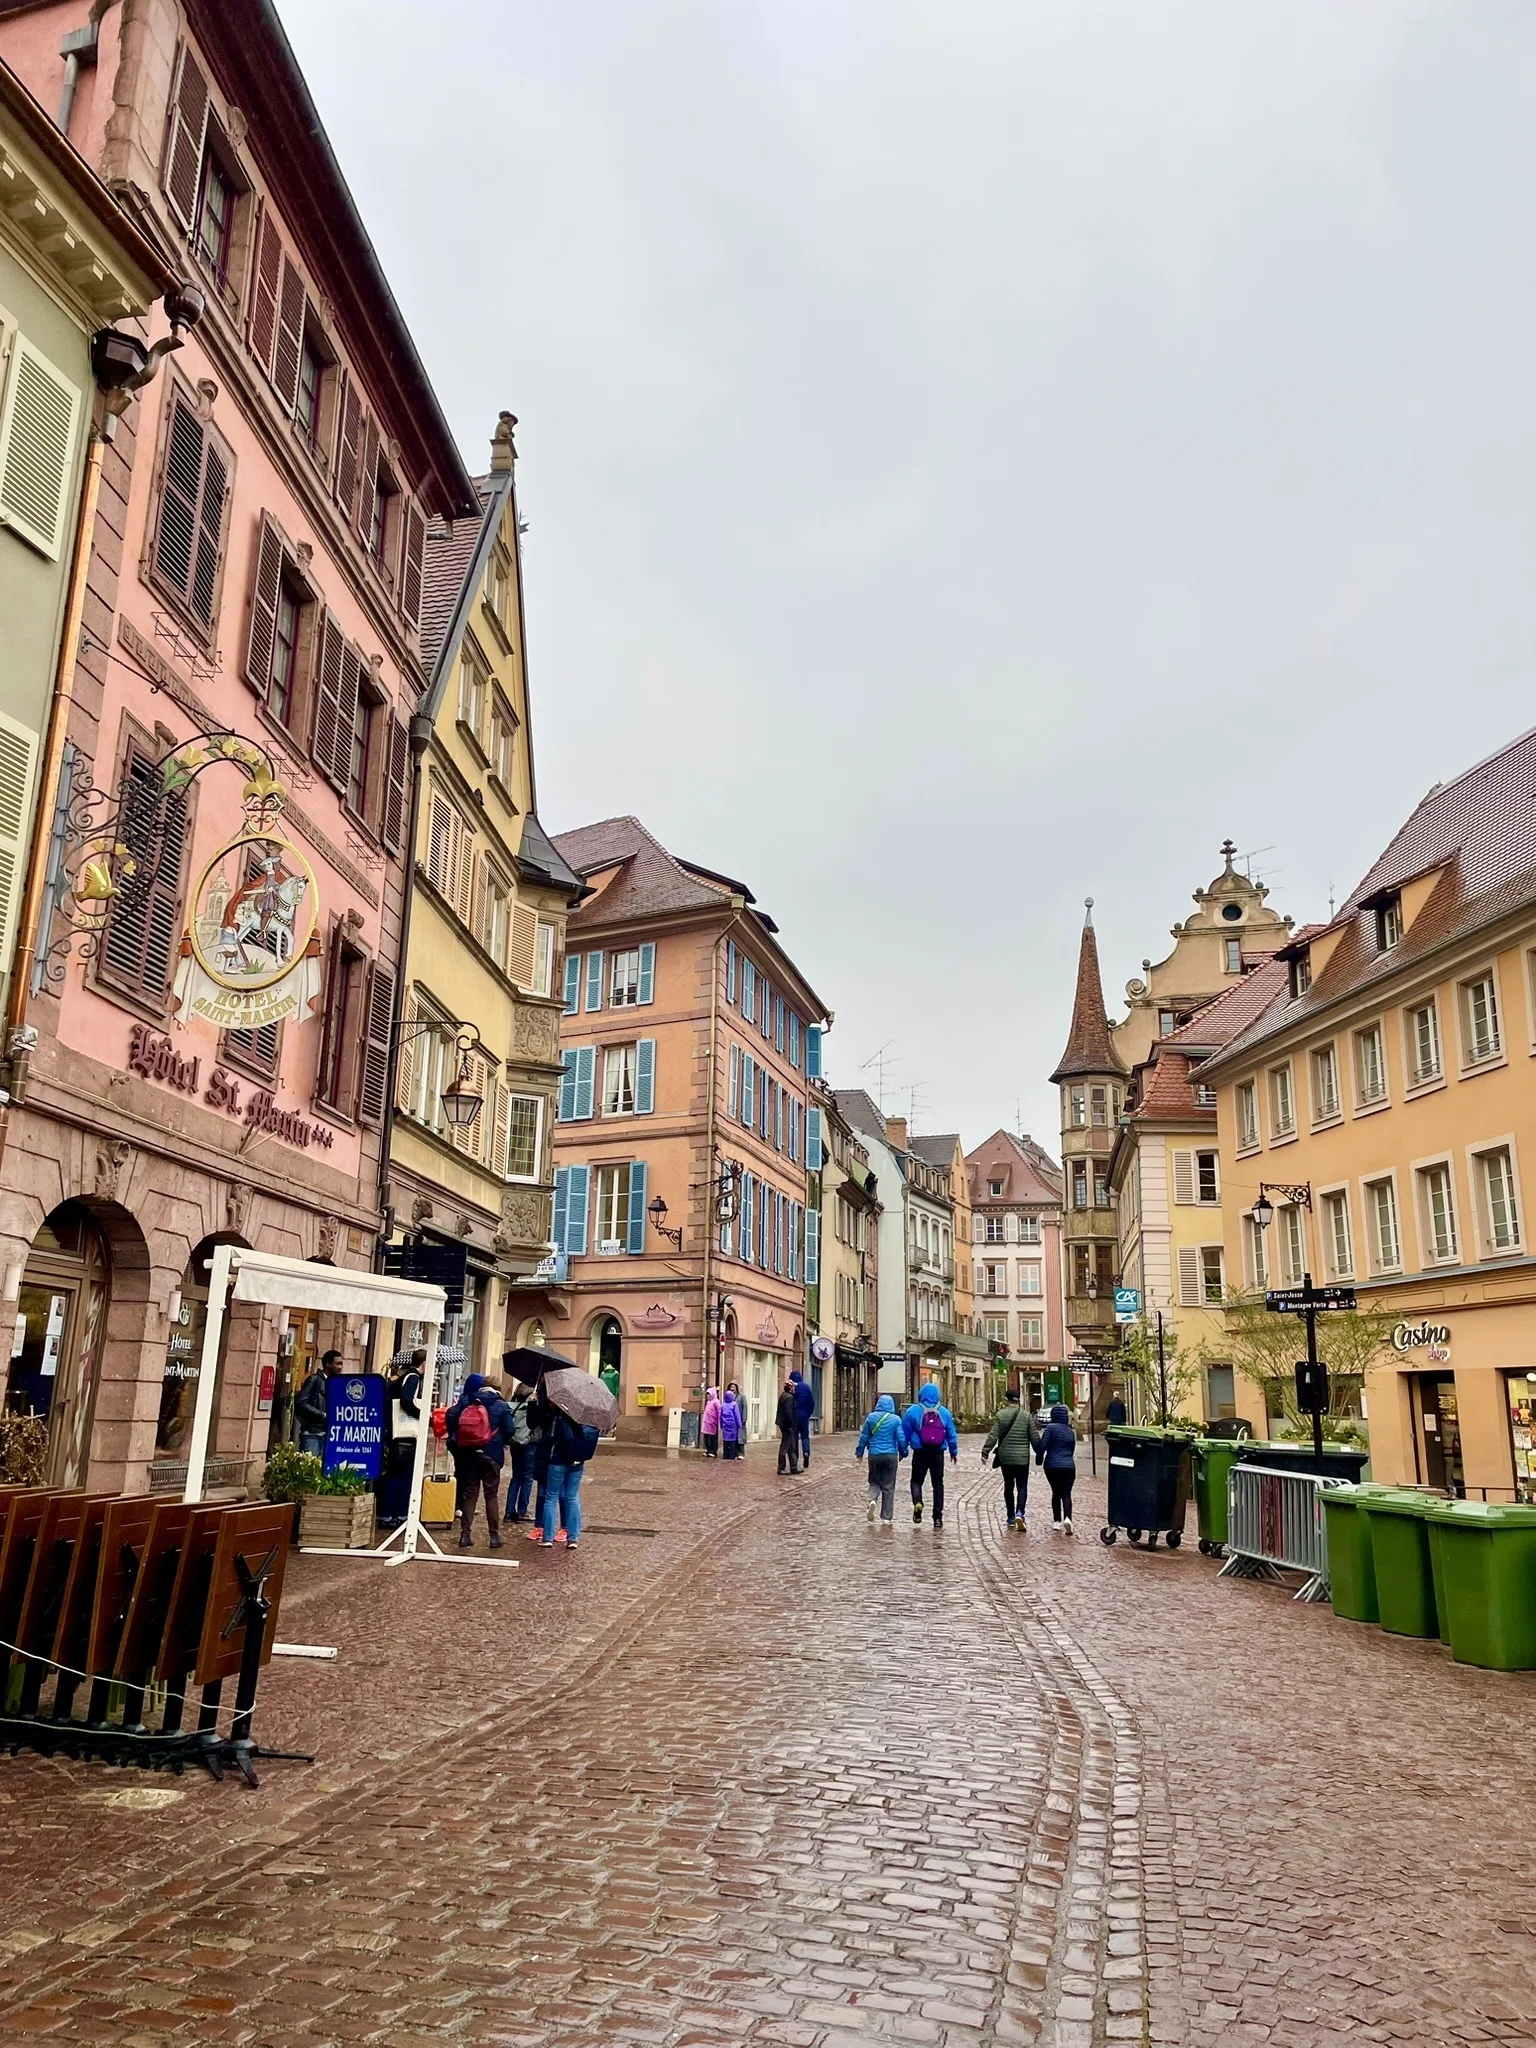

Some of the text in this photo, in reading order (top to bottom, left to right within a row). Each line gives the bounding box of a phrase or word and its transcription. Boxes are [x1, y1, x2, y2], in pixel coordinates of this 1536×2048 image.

[214, 990, 278, 1009] HOTEL
[192, 994, 298, 1025] SAINT-MARTIN
[129, 1023, 202, 1094] Hôtel
[243, 1090, 312, 1148] Martin
[1287, 1302, 1312, 1310] Montagne
[1391, 1320, 1450, 1352] Casino
[335, 1405, 370, 1422] HOTEL
[329, 1425, 381, 1443] ST MARTIN
